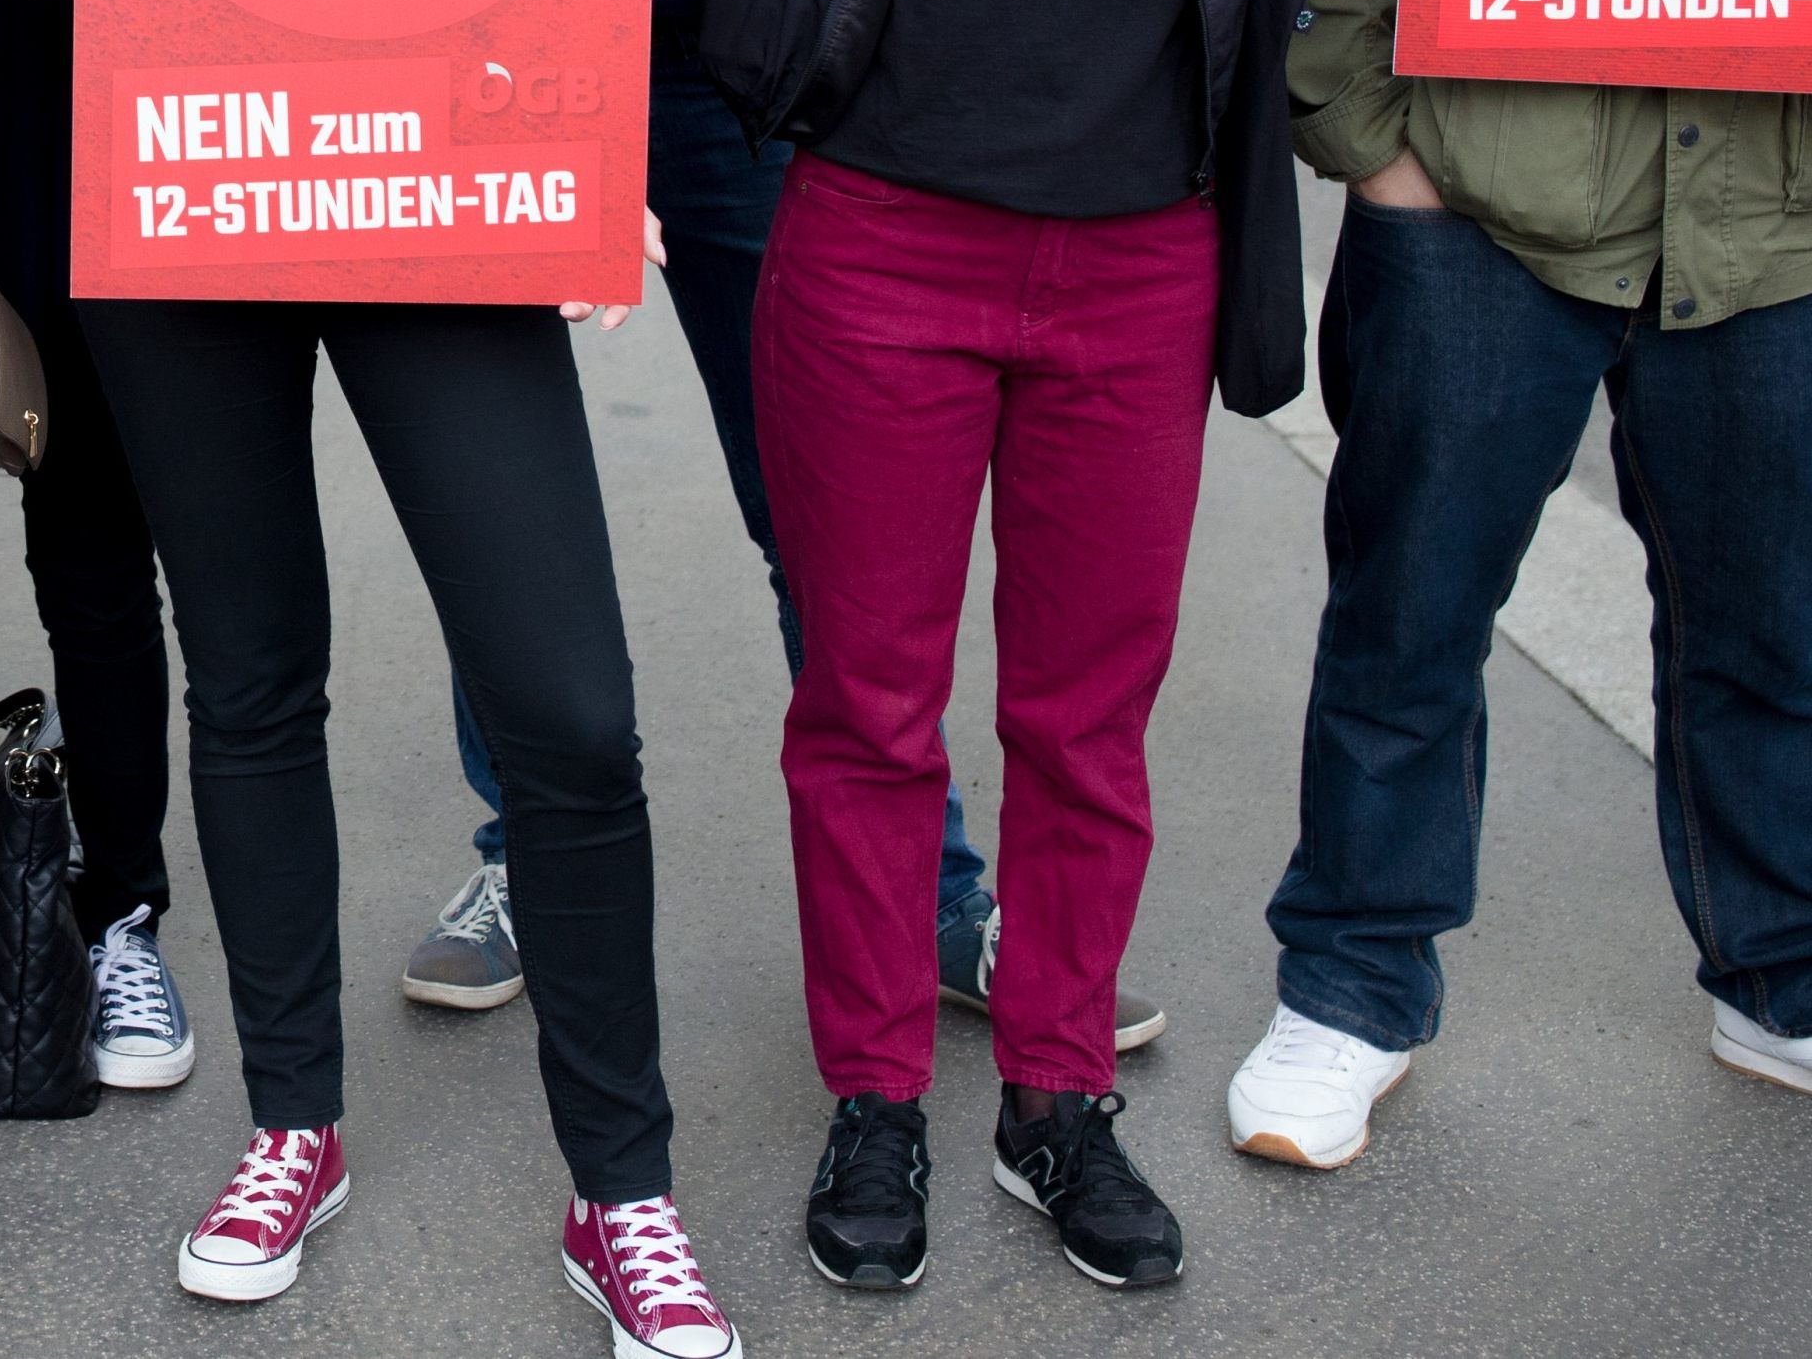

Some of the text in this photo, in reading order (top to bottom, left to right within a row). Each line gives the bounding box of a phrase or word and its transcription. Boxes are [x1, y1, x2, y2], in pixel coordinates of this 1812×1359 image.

[136, 90, 422, 163] NEIN zum
[132, 170, 576, 238] 12-STUNDEN-TAG
